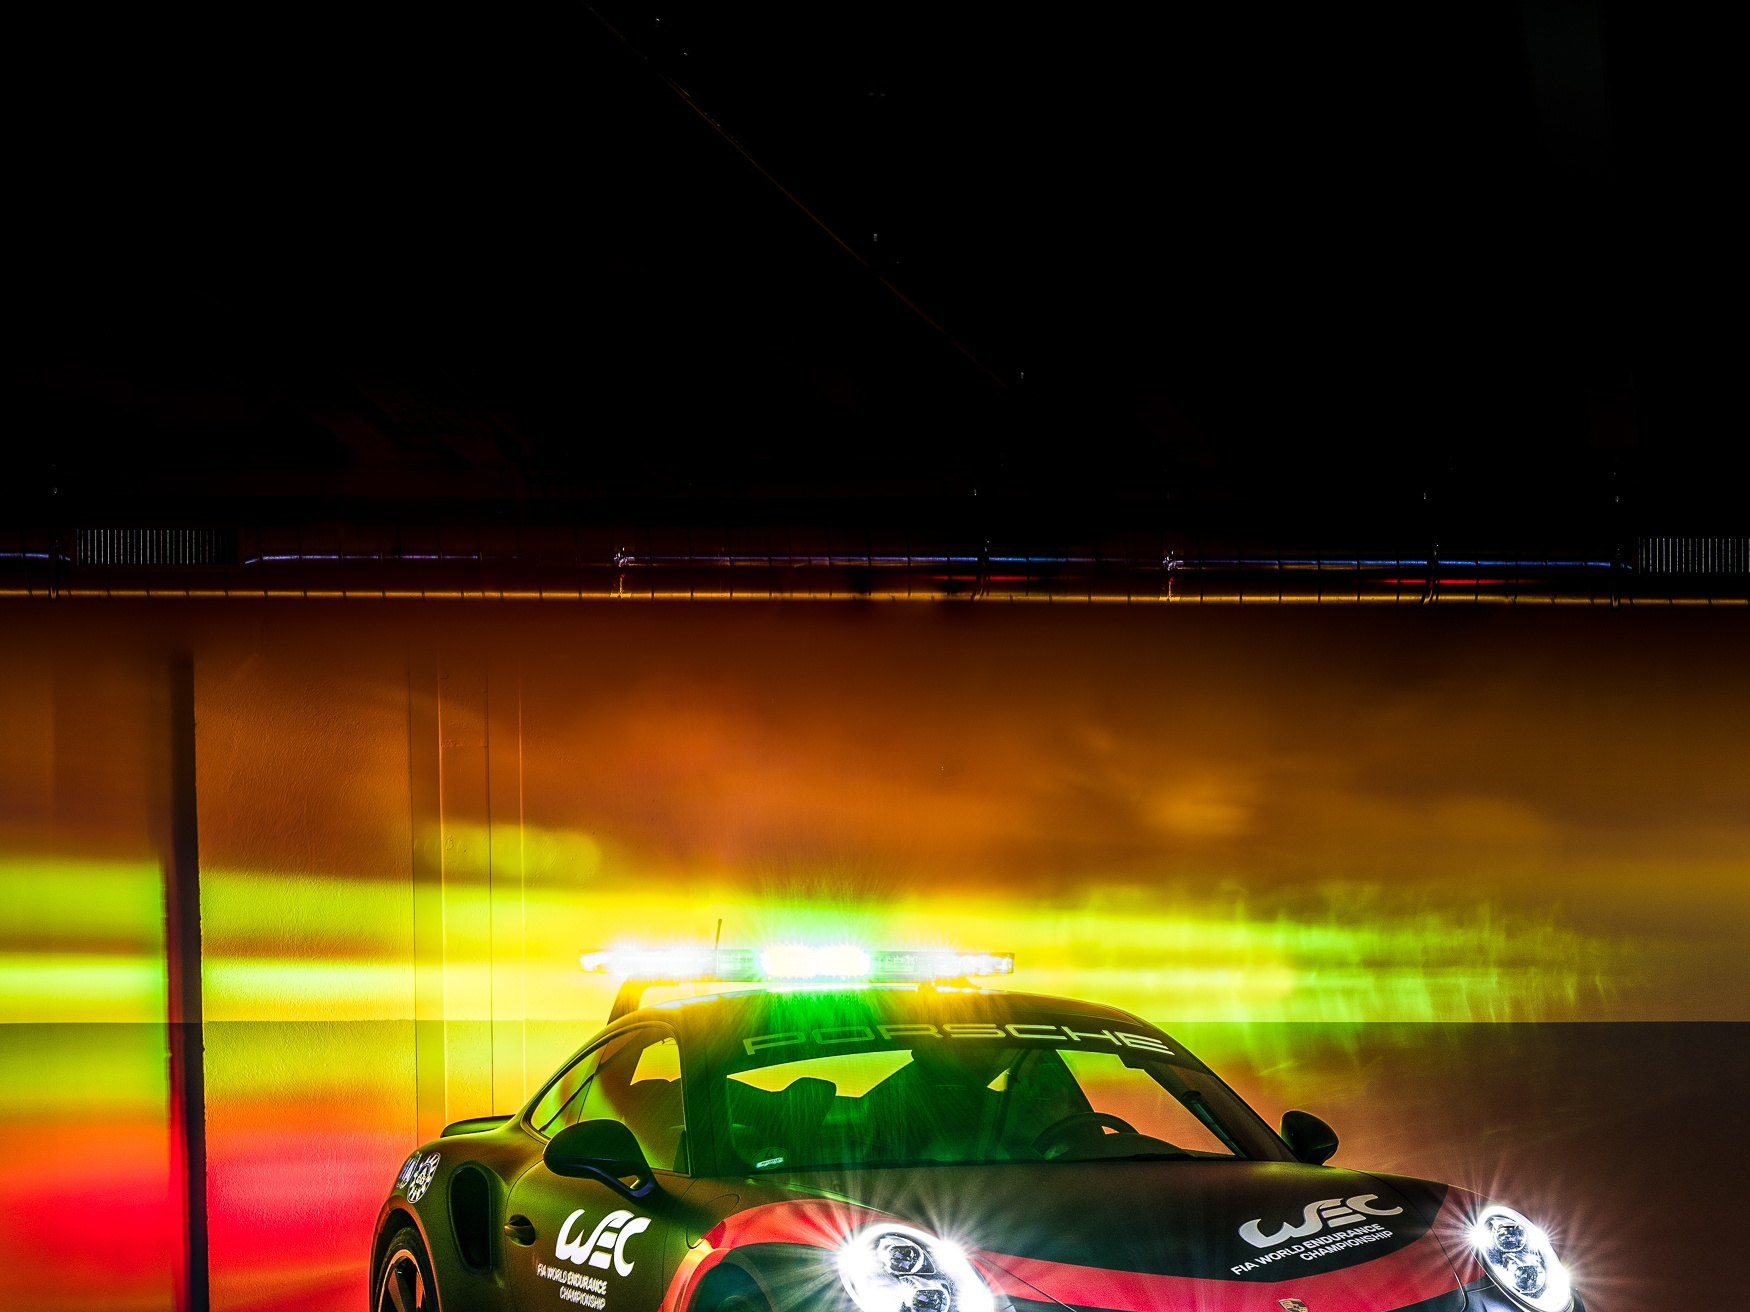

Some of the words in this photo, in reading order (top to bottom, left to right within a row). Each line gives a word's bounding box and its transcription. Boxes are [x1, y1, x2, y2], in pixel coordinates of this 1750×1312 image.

[742, 1023, 1175, 1056] PORSCHE
[555, 1208, 652, 1277] WEC
[1238, 1194, 1404, 1249] WEC
[1230, 1261, 1260, 1276] FIA
[1255, 1243, 1306, 1266] WORLD
[1302, 1223, 1386, 1250] ENDURANCE
[1299, 1230, 1394, 1262] CHAMPIONSHIP
[566, 1270, 608, 1295] ENDURANCE
